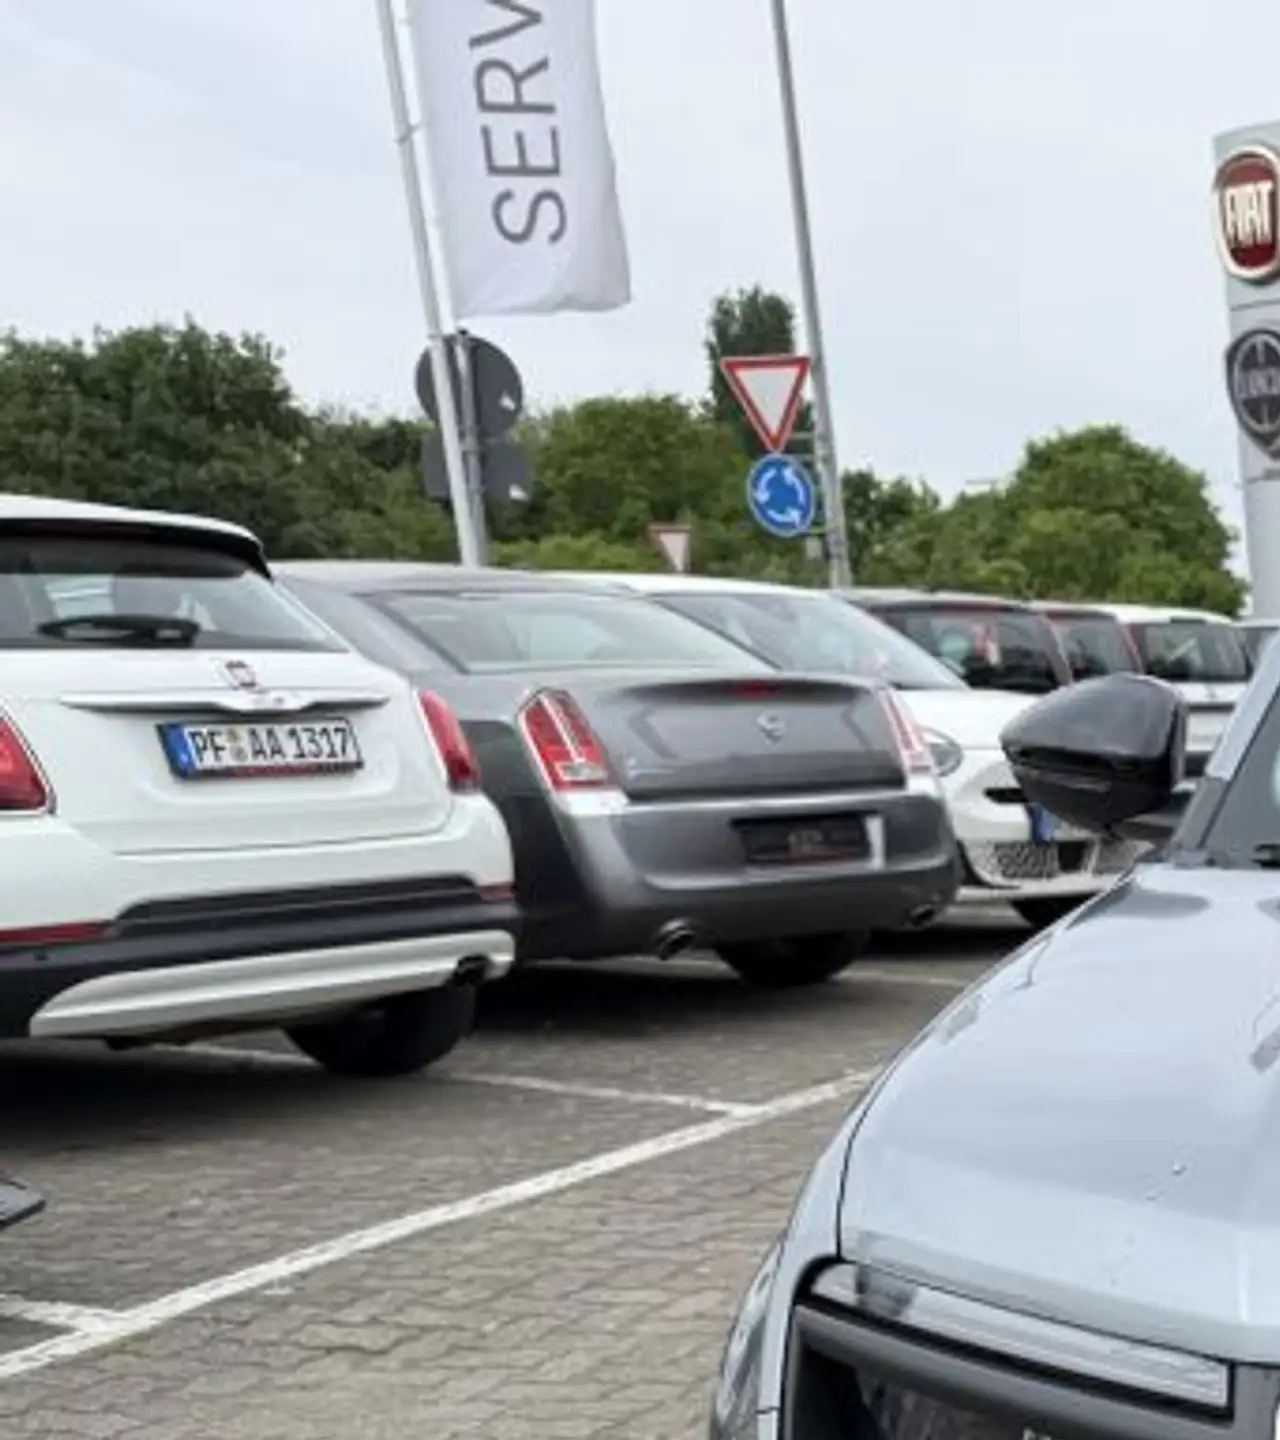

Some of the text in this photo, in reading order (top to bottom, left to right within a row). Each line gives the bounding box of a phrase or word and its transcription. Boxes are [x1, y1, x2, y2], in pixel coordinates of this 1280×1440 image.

[189, 725, 348, 763] PF AA 1317
